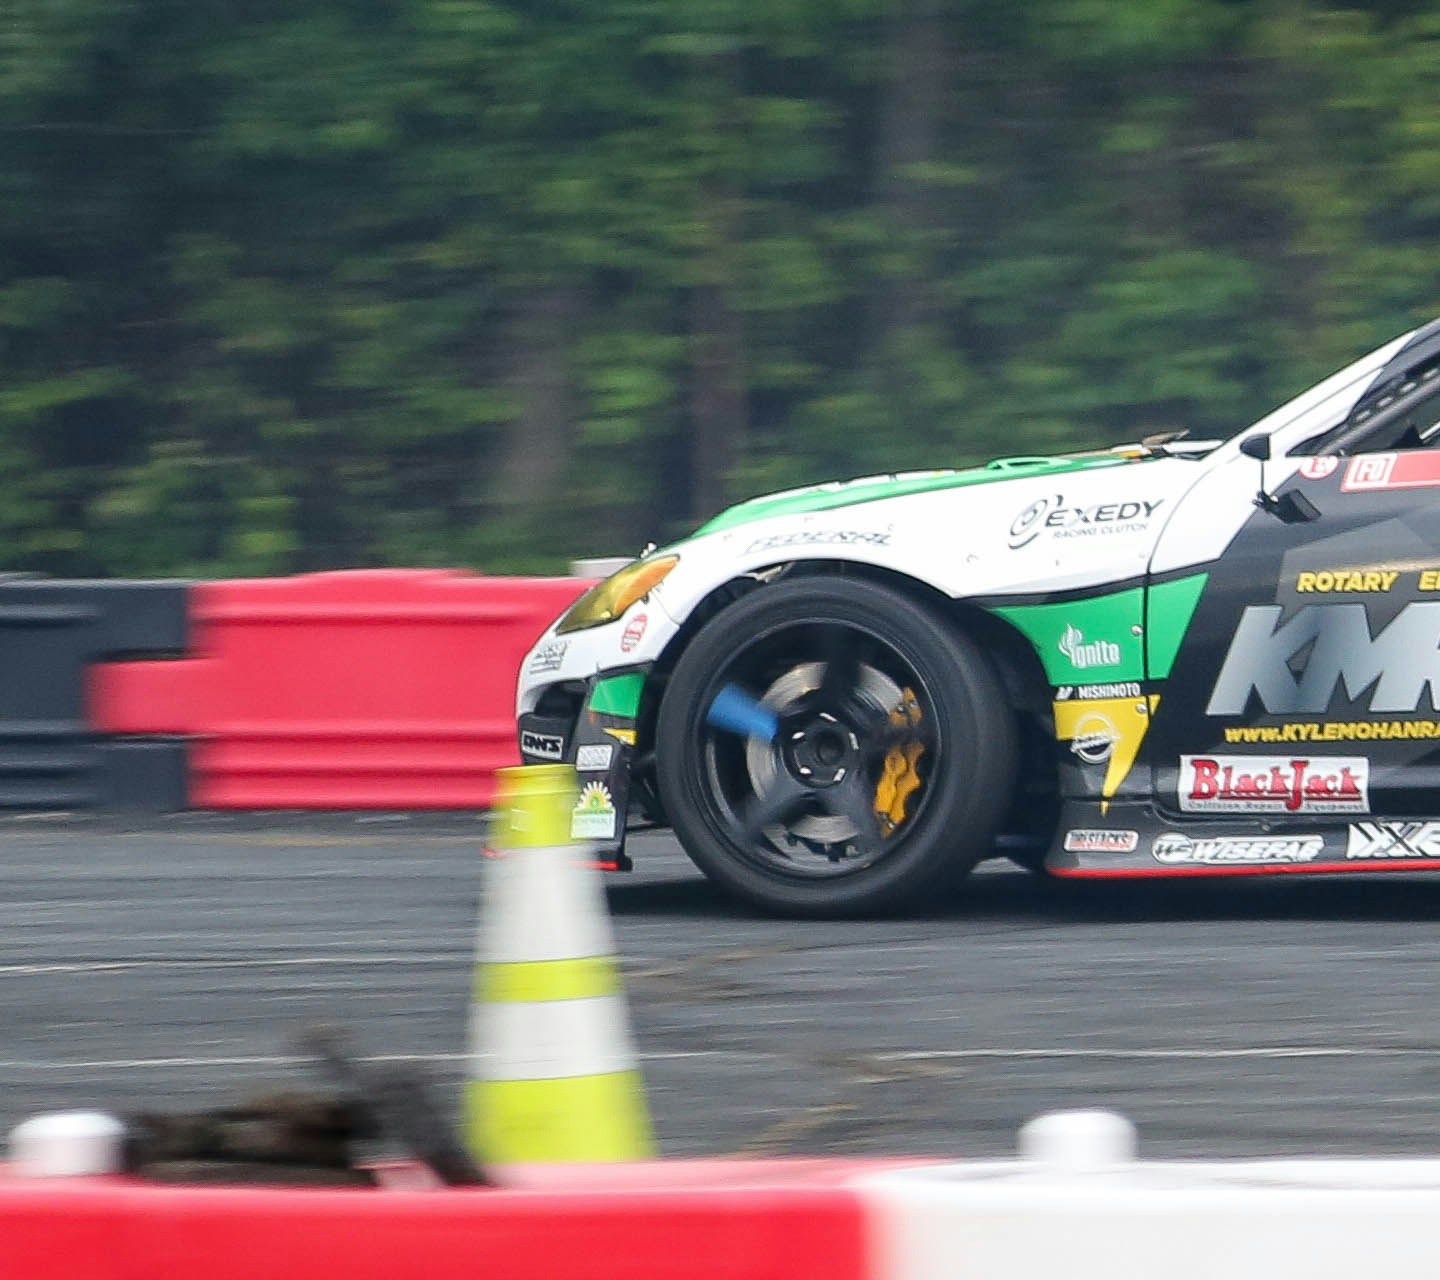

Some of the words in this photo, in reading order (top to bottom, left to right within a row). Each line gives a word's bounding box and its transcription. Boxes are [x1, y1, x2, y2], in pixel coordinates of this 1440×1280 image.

[1044, 498, 1165, 528] EXEDY
[1296, 571, 1400, 593] ROTARY
[1077, 682, 1141, 699] MISHIMOTO
[1188, 759, 1362, 811] BlackJack
